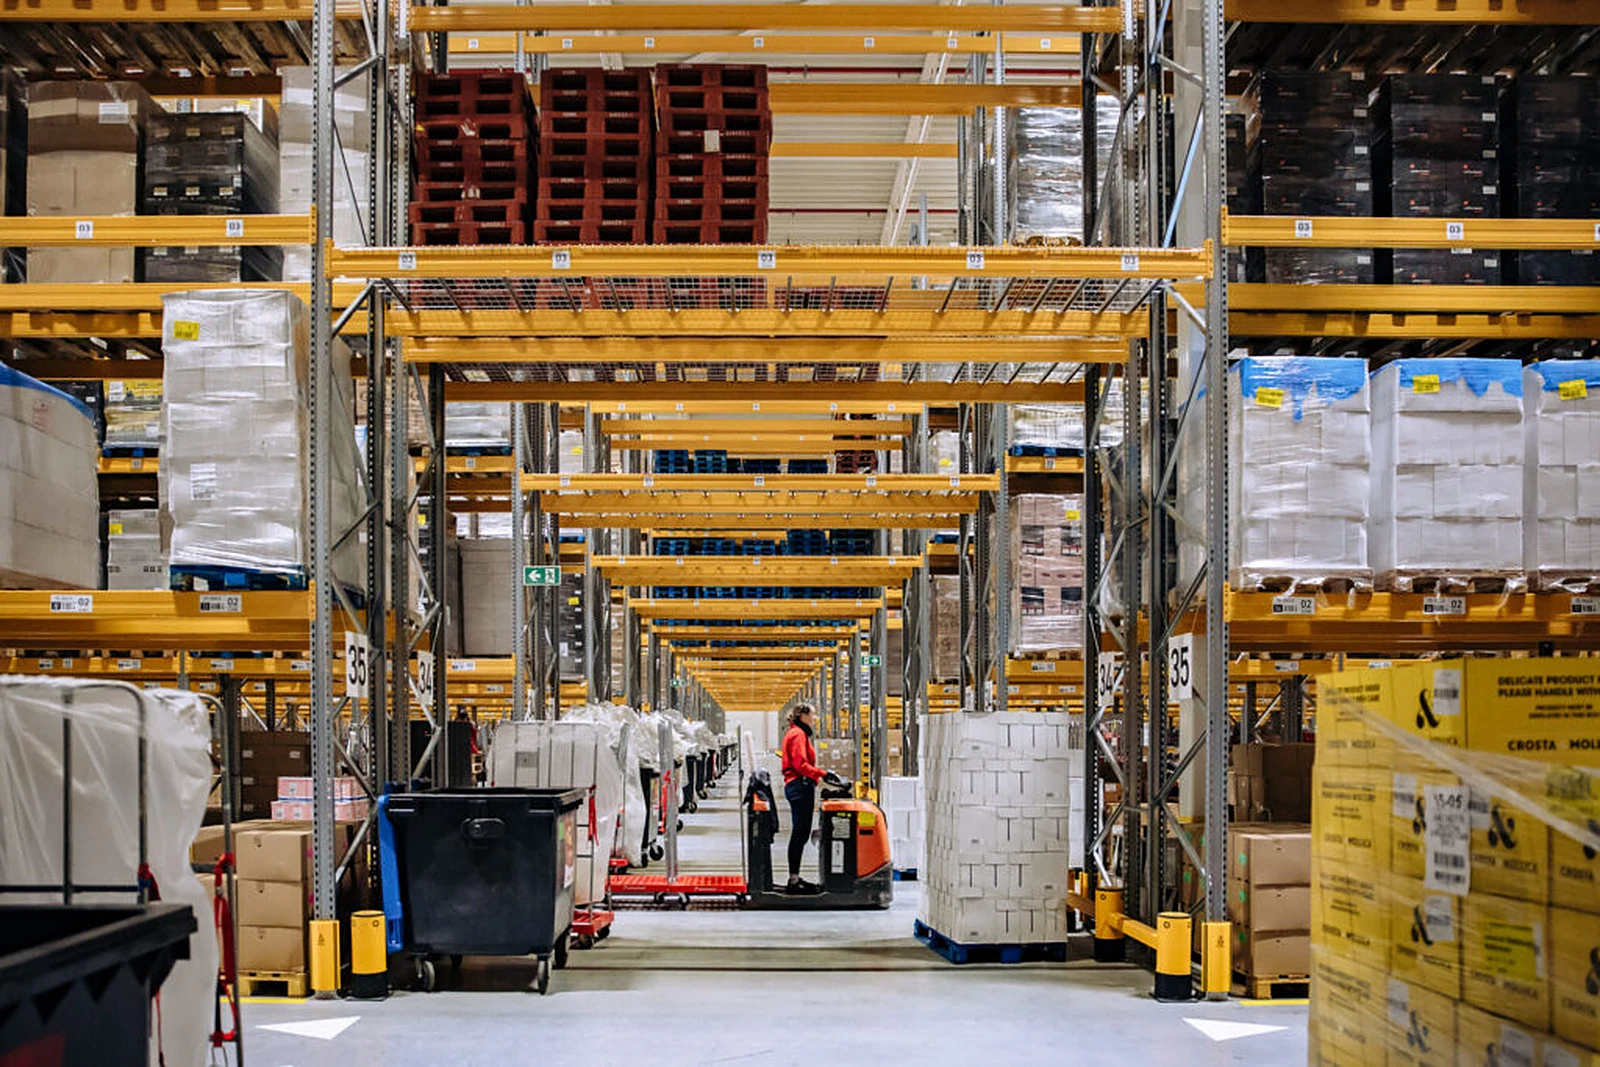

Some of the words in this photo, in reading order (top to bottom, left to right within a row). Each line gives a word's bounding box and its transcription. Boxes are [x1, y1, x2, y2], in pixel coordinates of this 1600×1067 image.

[1297, 222, 1310, 231] 03
[1449, 225, 1461, 233] 03
[78, 597, 90, 606] 02
[227, 597, 239, 606] 02
[1300, 599, 1312, 609] 02
[1451, 599, 1463, 609] 02
[348, 645, 367, 686] 35
[1170, 646, 1190, 688] 35
[420, 661, 432, 695] 34
[1100, 662, 1113, 696] 34
[1498, 675, 1543, 686] DELICATE
[1546, 674, 1595, 685] PRODUCT
[1498, 687, 1532, 698] PLEASE
[1535, 687, 1574, 697] HANDLE
[1507, 739, 1557, 751] CROSTA
